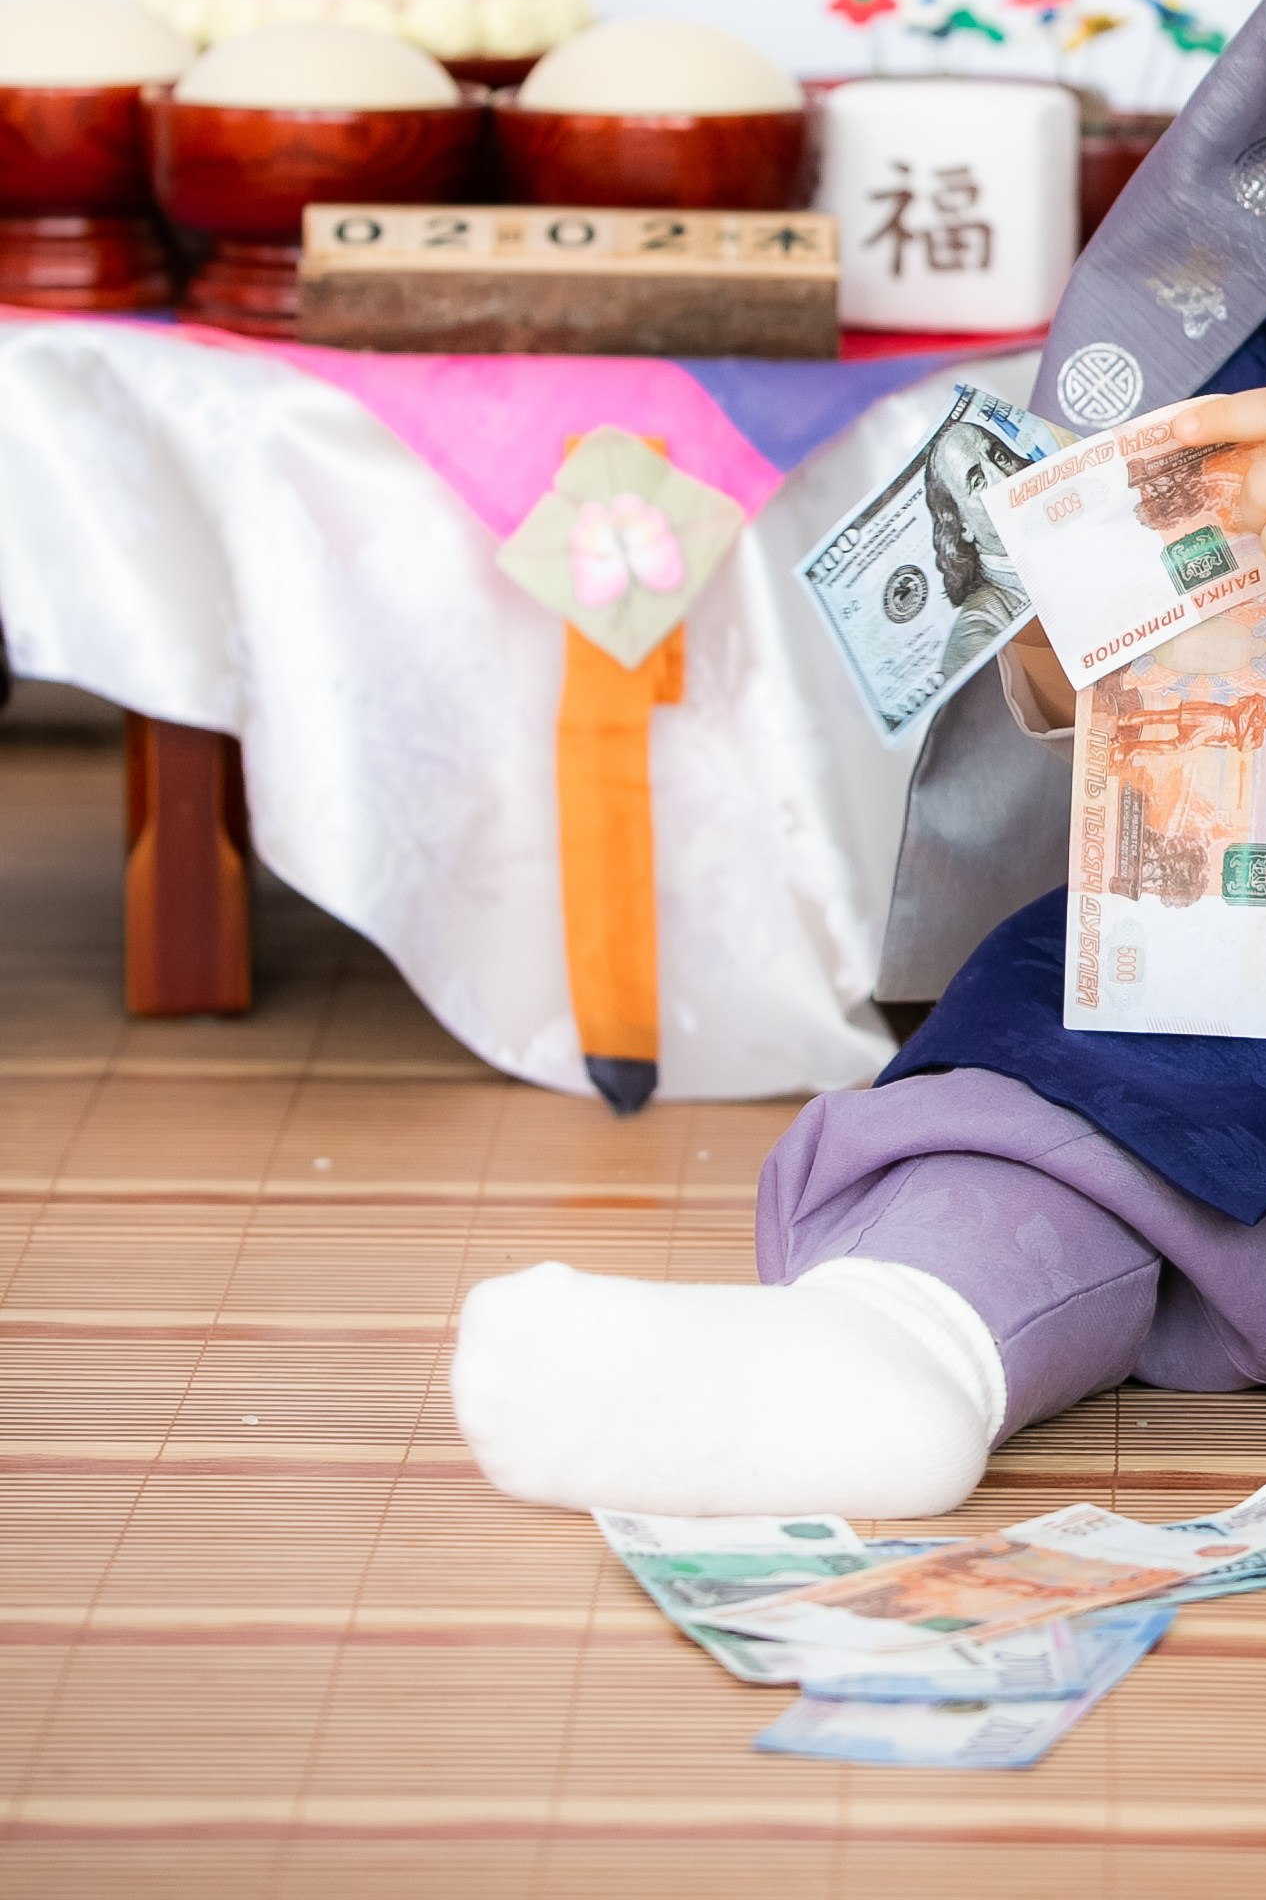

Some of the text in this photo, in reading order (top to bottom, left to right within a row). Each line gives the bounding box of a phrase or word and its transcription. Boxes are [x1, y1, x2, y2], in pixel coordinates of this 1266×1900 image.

[862, 159, 995, 278] 福
[1008, 417, 1176, 509] СЯЧ ДУБЛЕЙ
[1046, 491, 1083, 523] 5000
[1081, 568, 1261, 670] БАНКА ПРИКОЛОВ
[1076, 728, 1110, 1010] ПЯТЬ ТЫСЯЧ ДУБЛЕЙ
[1116, 946, 1137, 983] 5000
